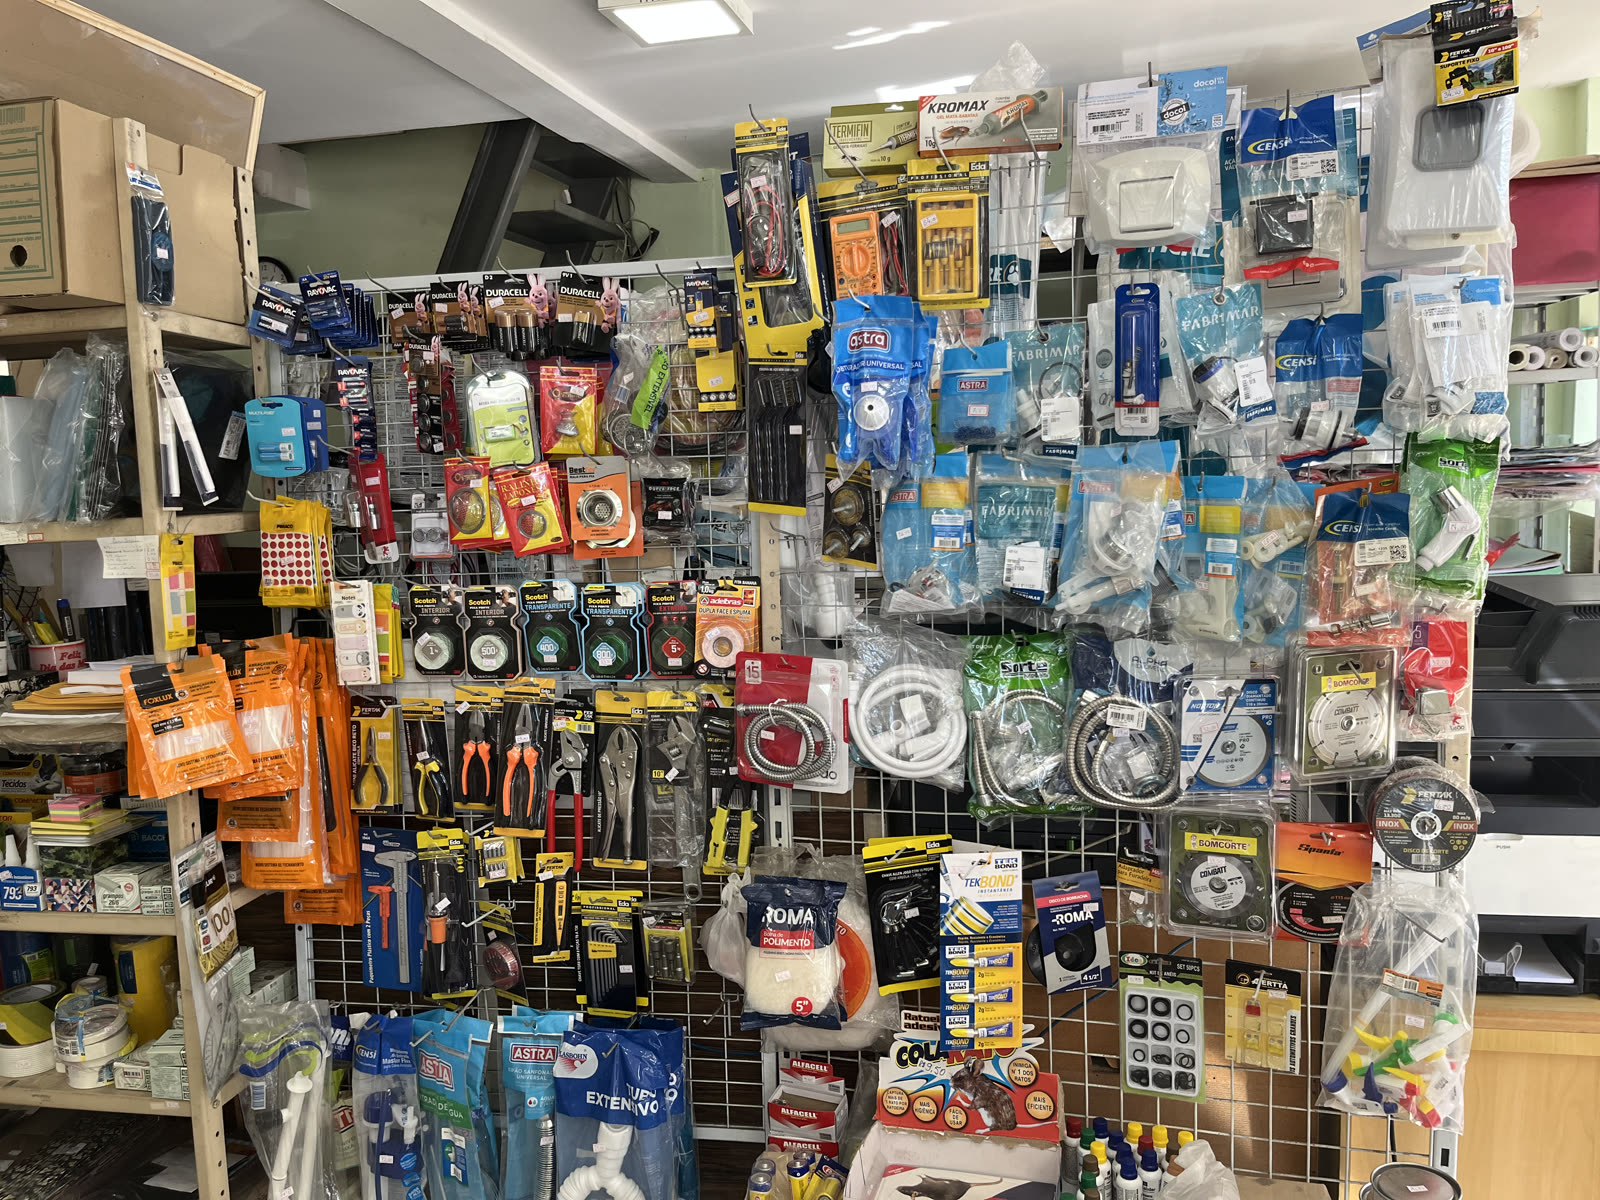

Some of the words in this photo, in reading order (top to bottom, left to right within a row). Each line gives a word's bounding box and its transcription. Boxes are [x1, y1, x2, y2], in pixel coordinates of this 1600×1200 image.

[1440, 59, 1466, 69] SUPORTE
[1194, 79, 1216, 88] docol
[928, 100, 990, 114] KROMAX
[1164, 106, 1186, 119] docol
[832, 124, 869, 138] TERMIFIN
[970, 163, 986, 171] Eda
[306, 284, 337, 298] RAYOVAC
[431, 292, 456, 300] DURACELL
[485, 288, 528, 297] DURACELL
[560, 286, 600, 299] DURACELL
[262, 299, 297, 318] RAYOVAC
[388, 302, 414, 310] DURACELL
[1182, 306, 1260, 330] FABRIMAR
[850, 332, 886, 349] astra
[1011, 345, 1080, 362] FABRIMAR
[866, 360, 904, 370] UNIVERSAL
[338, 368, 368, 376] RAYOVAC
[959, 380, 988, 390] ASTRA
[1246, 406, 1273, 418] FABRIMAR
[525, 602, 571, 610] TRANSPARENTE
[59, 662, 76, 671] das
[746, 665, 759, 679] 15
[143, 693, 173, 706] FOXLUX
[1334, 706, 1359, 716] COMBATT
[2, 780, 26, 788] Tecidos
[1418, 791, 1452, 799] FERTAK
[1199, 839, 1248, 851] BOMCORTE
[1200, 866, 1226, 878] COMBATT
[965, 874, 1015, 888] TEKBOND
[762, 905, 814, 926] ROMA
[1052, 911, 1094, 925] ROMA
[763, 937, 811, 947] POLIMENTO
[904, 1014, 940, 1022] Ratoei
[904, 1022, 940, 1031] adesiv
[513, 1047, 556, 1061] ASTRA
[896, 1041, 950, 1068] COLA
[792, 1061, 828, 1072] ALFACELL
[1027, 1103, 1052, 1112] EFICIENTE
[781, 1108, 817, 1119] ALFACELL
[784, 1141, 821, 1150] ALFACELL
